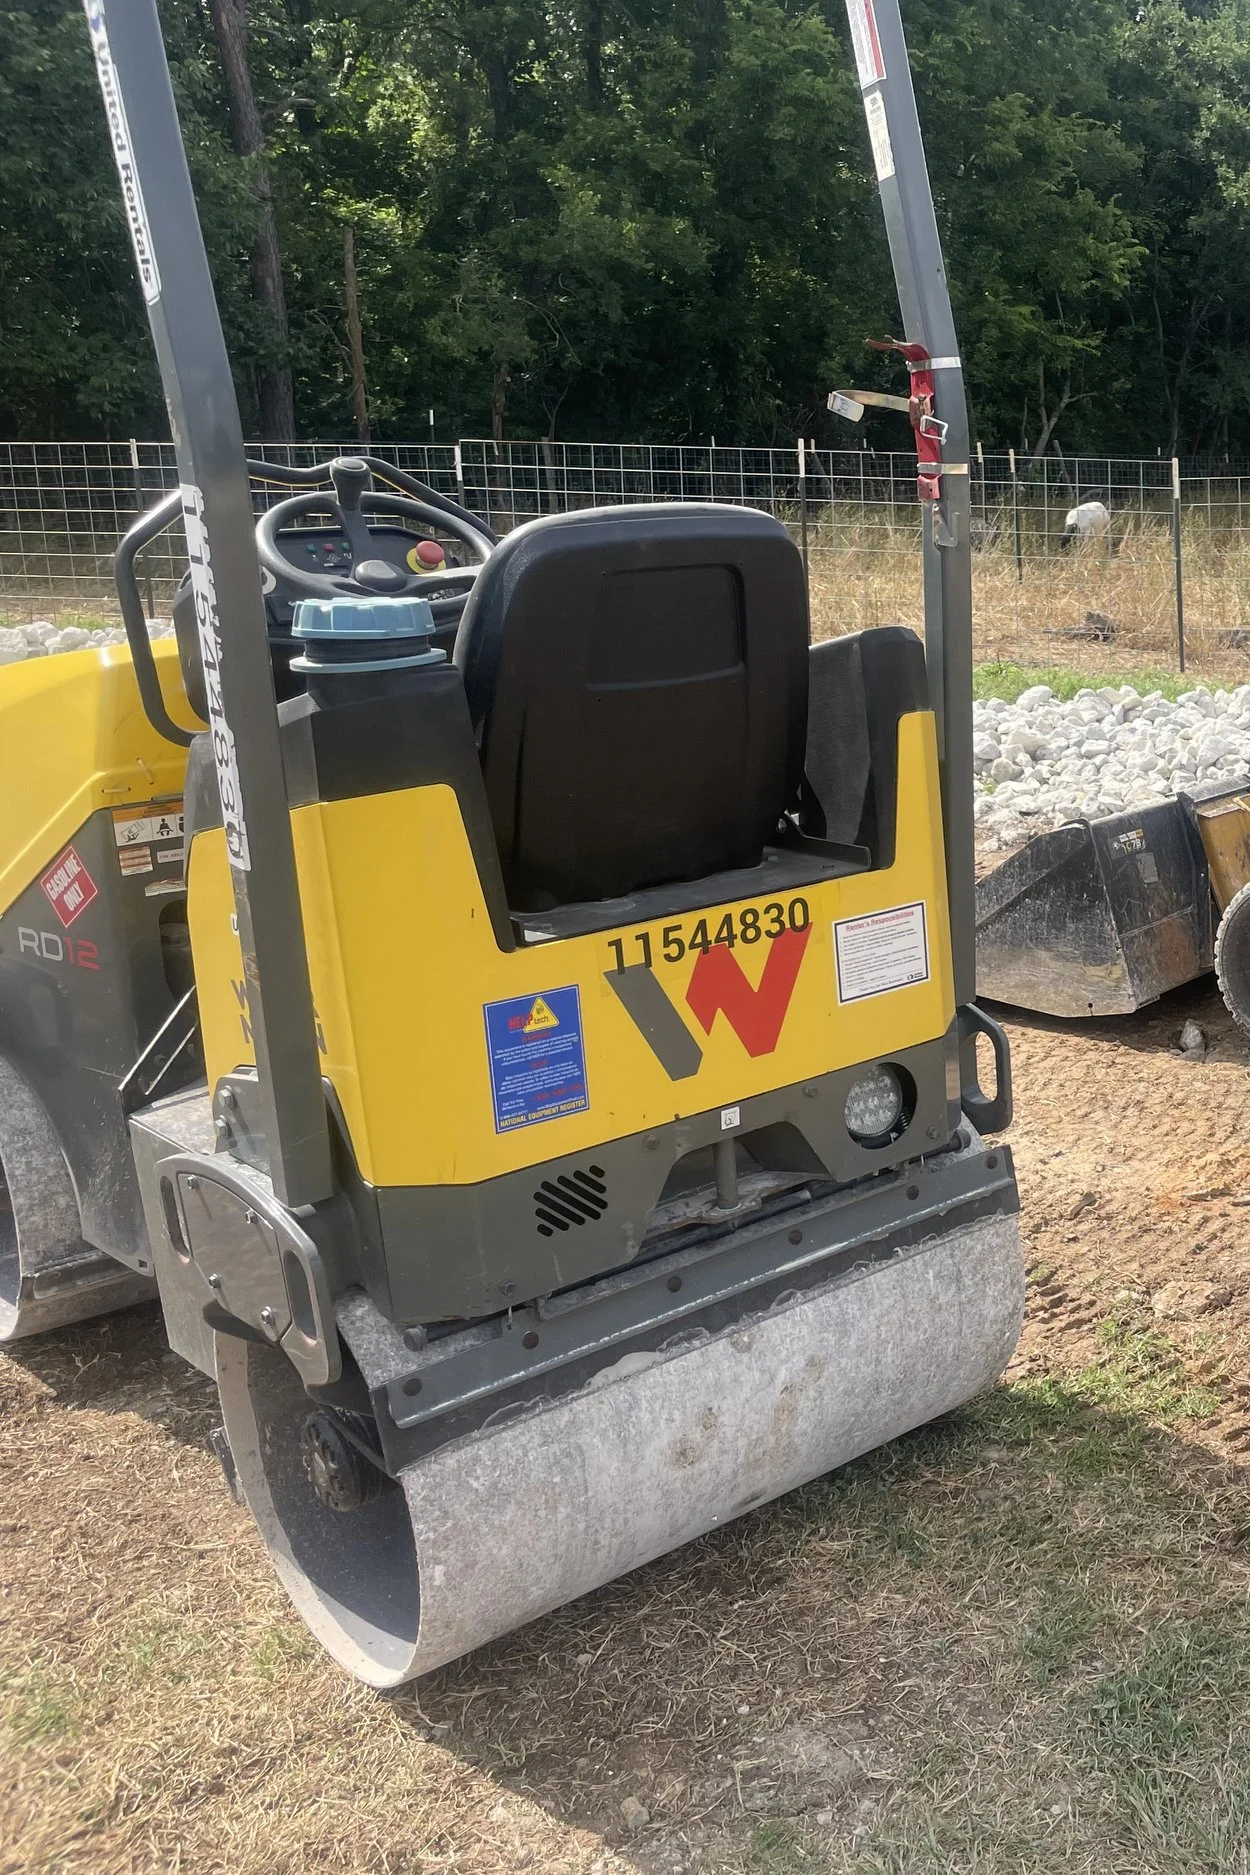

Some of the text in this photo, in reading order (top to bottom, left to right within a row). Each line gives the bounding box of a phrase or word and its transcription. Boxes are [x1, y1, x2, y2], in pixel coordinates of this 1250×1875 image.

[98, 42, 152, 283] United Rentals
[184, 490, 246, 863] 11544830
[46, 854, 81, 901] GASOLINE
[63, 881, 84, 911] ONLY
[607, 897, 810, 976] 11544830
[846, 911, 914, 932] Renter's Responsibilities
[18, 926, 101, 971] RD12
[507, 1013, 533, 1030] HELP
[500, 1115, 527, 1128] NATIONAL
[528, 1106, 560, 1120] EQUIPMENT
[560, 1099, 586, 1111] REGISTER
